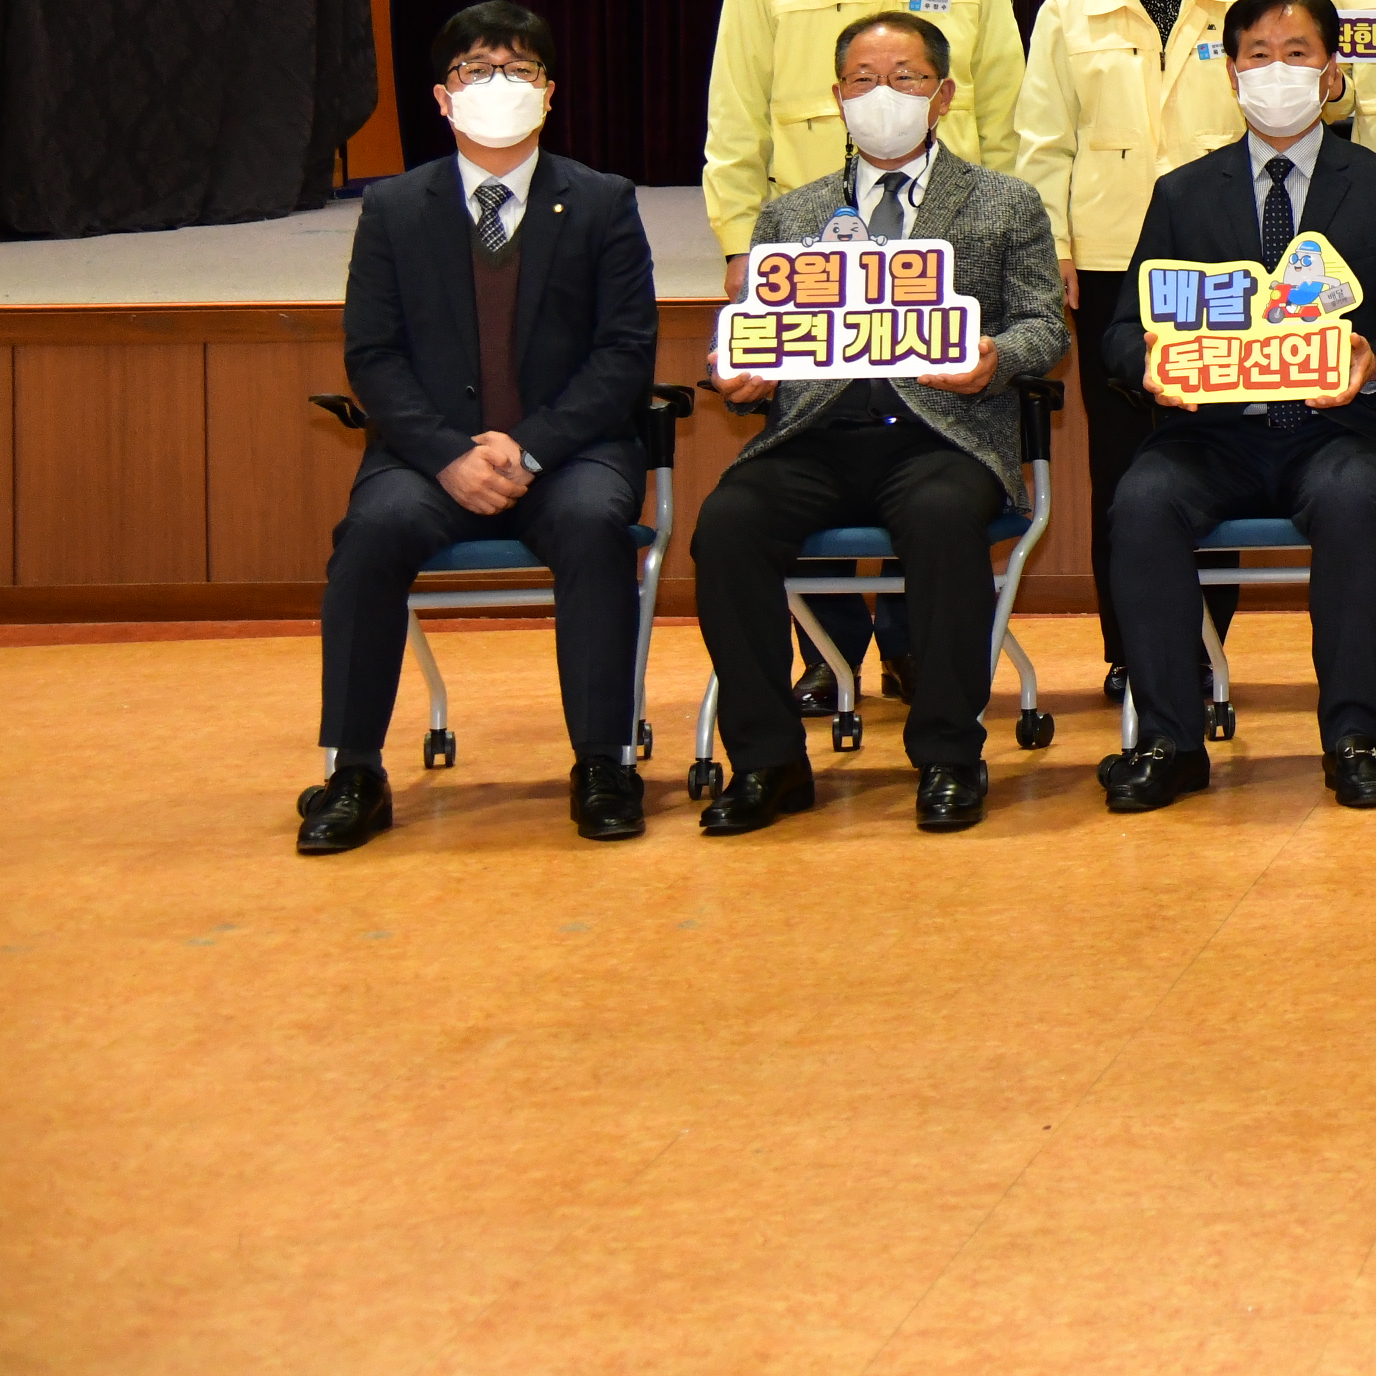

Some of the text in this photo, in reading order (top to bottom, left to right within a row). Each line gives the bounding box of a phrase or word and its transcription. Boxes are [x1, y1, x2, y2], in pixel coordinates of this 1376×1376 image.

[756, 249, 944, 308] 3월 1일
[1149, 268, 1258, 331] 배달
[729, 307, 968, 369] 본격 개시!
[1157, 326, 1341, 392] 독립선언!
